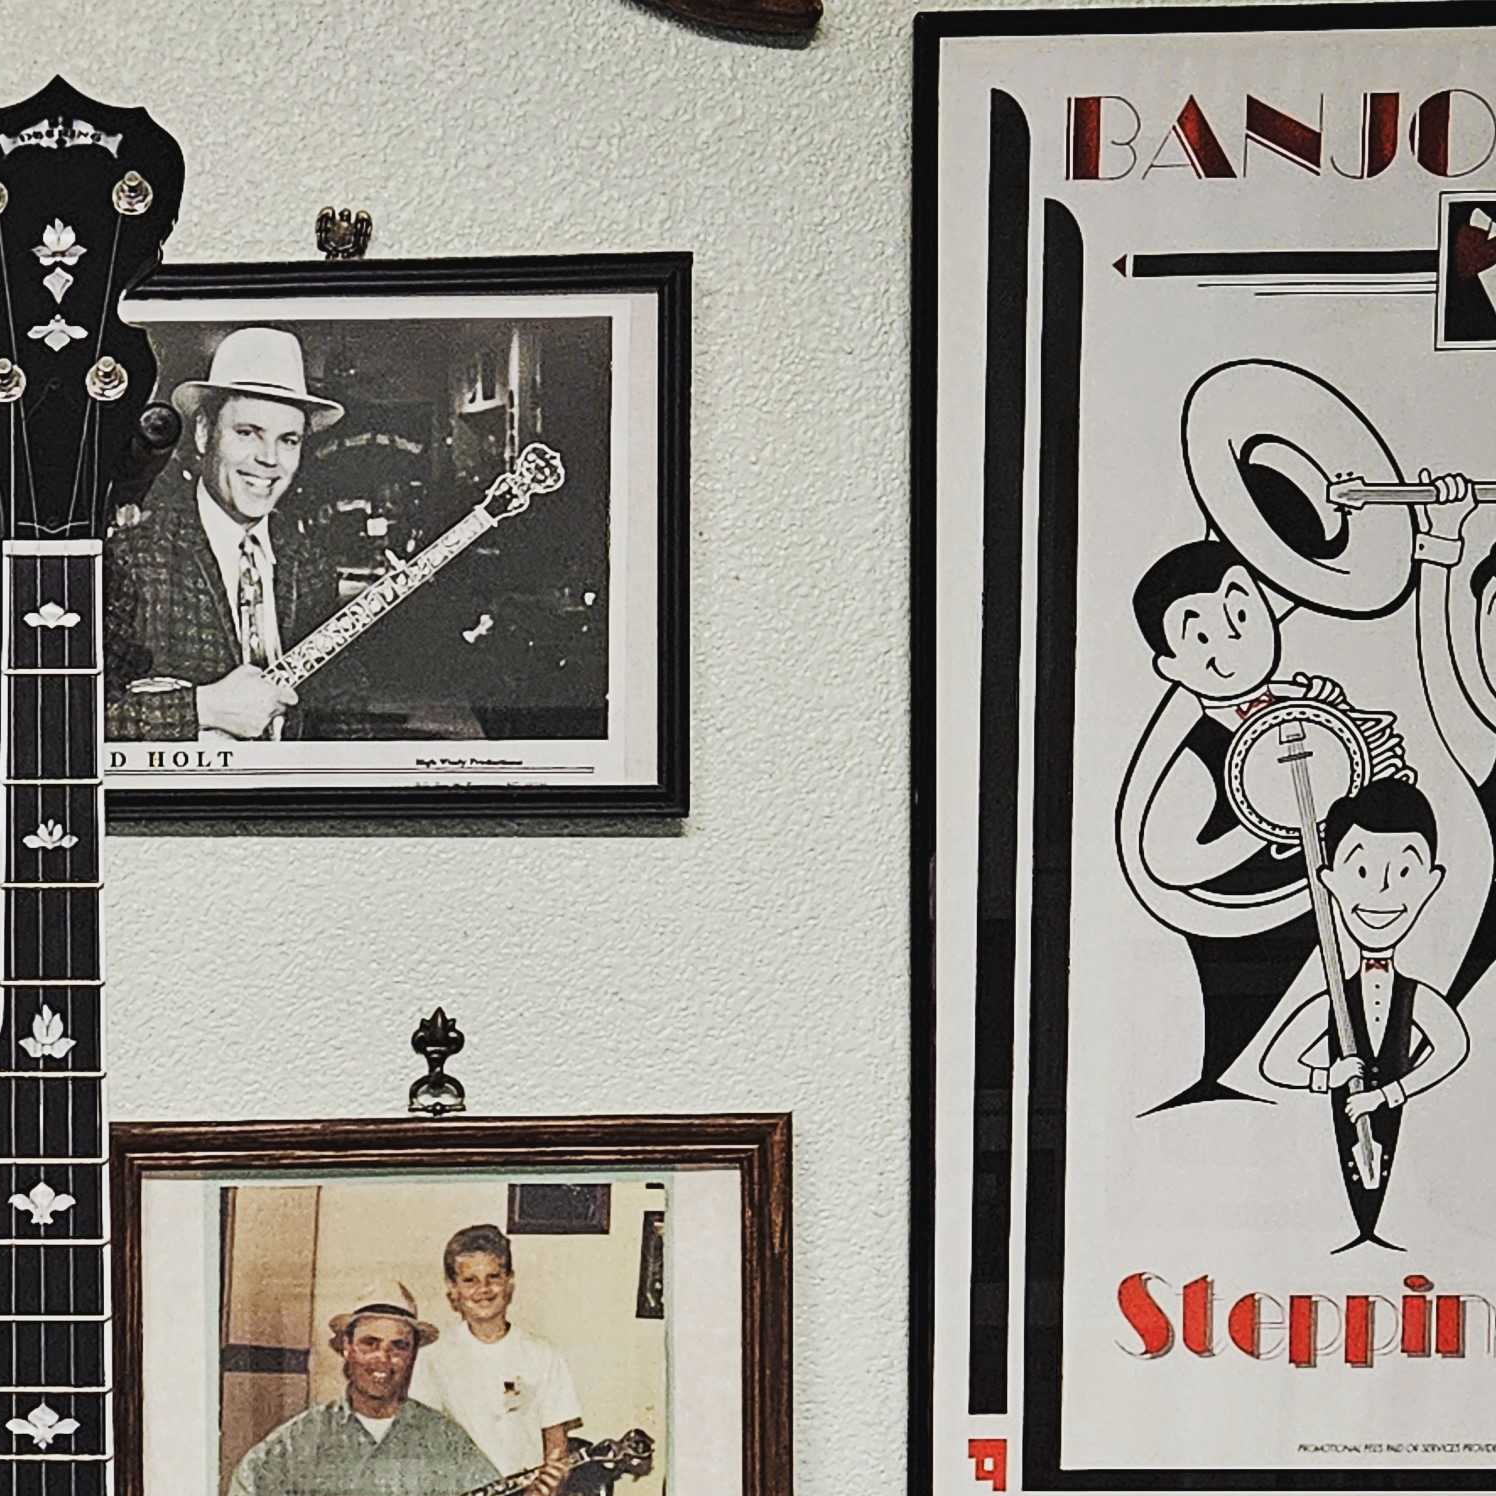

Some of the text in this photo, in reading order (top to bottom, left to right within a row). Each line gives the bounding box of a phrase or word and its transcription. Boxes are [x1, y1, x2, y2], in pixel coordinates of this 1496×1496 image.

[18, 127, 103, 143] DEERING
[1065, 88, 1496, 181] BANJO
[147, 750, 234, 768] HOLT
[1114, 1271, 1496, 1368] Steppin
